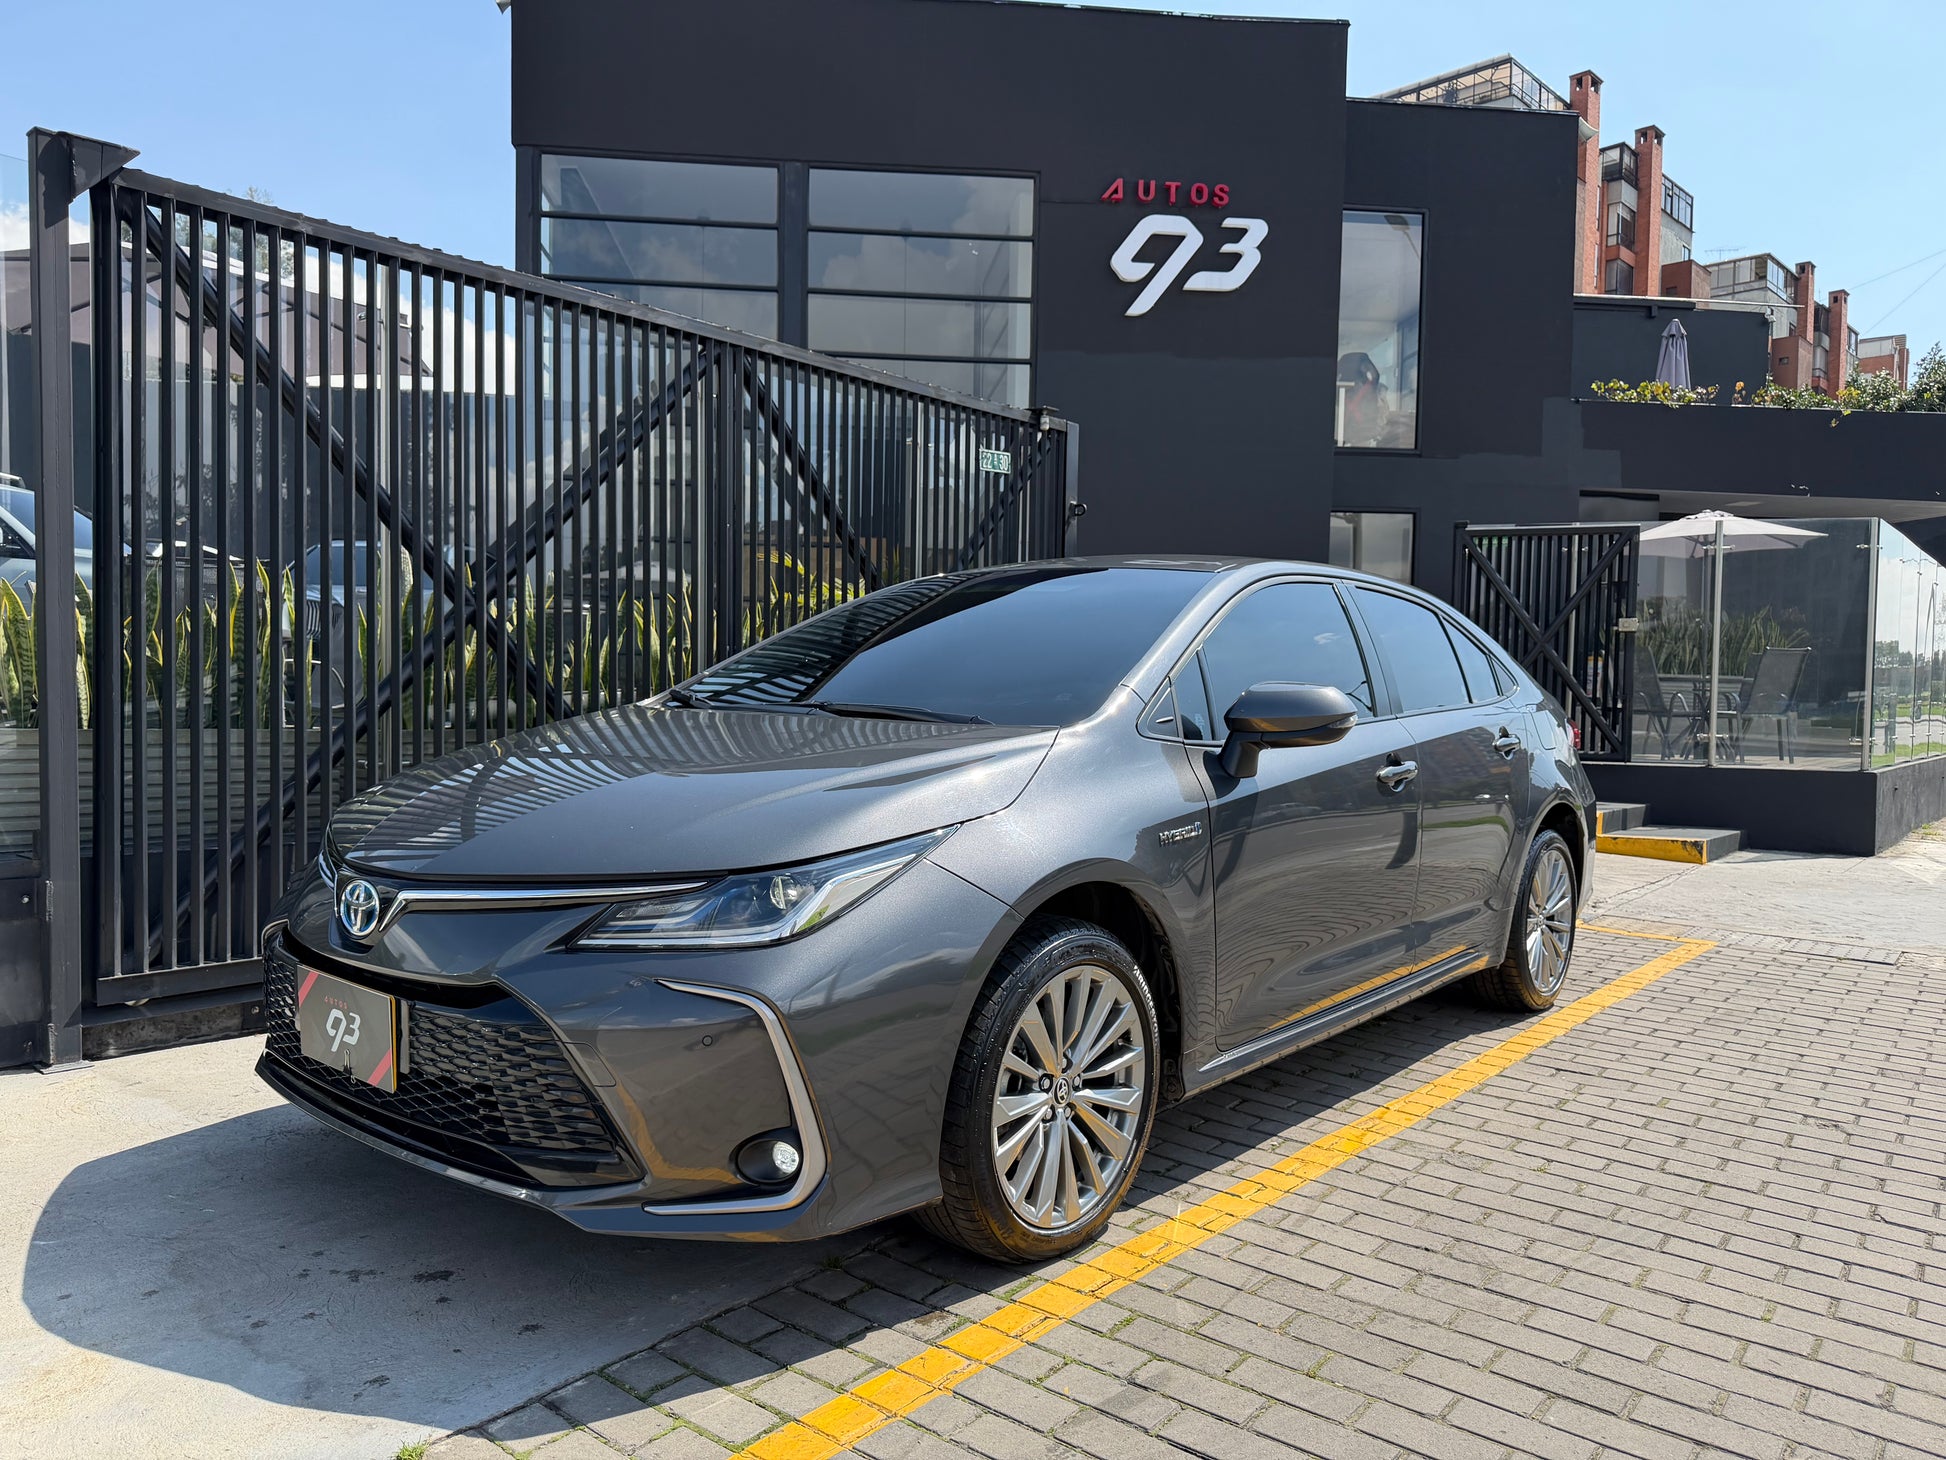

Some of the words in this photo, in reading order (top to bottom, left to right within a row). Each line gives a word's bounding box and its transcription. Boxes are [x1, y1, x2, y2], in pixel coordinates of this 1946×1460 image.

[1101, 178, 1230, 207] AUTOS
[1110, 214, 1269, 317] 93
[326, 1009, 361, 1052] 93
